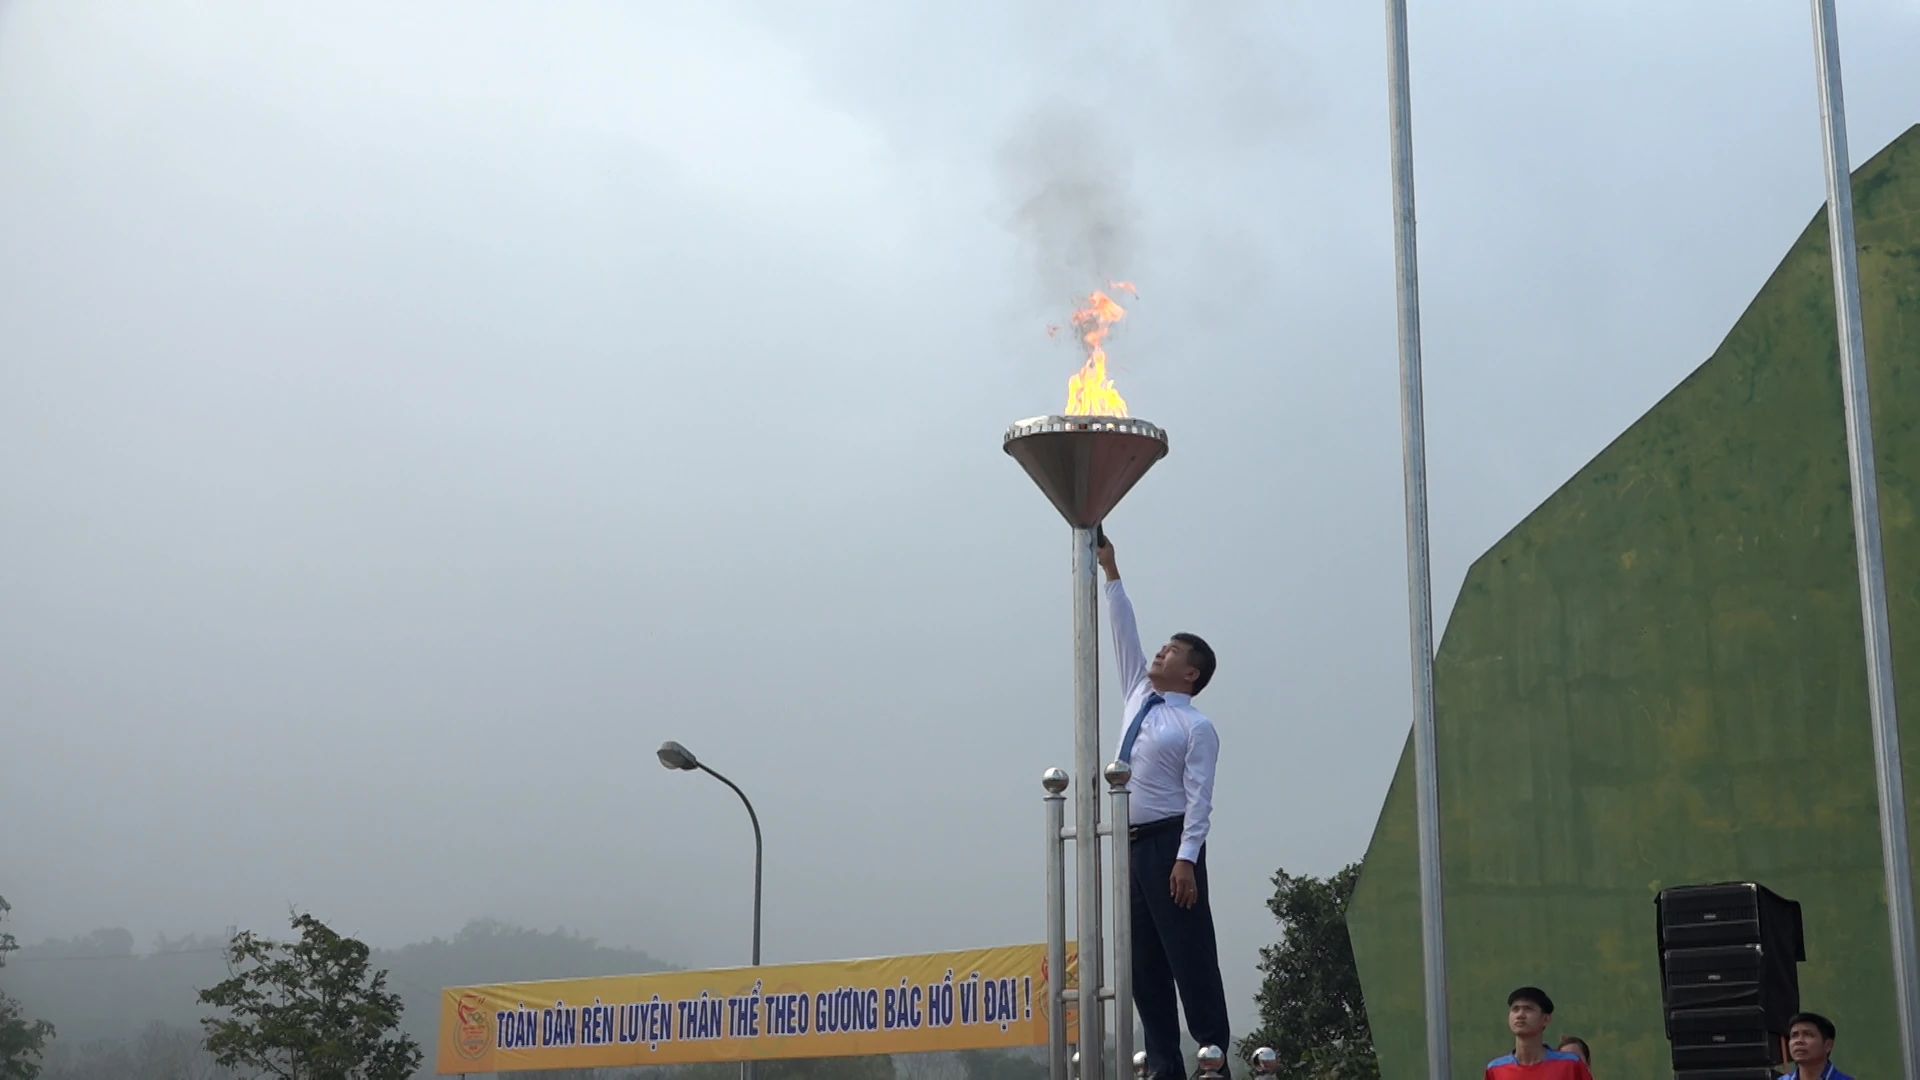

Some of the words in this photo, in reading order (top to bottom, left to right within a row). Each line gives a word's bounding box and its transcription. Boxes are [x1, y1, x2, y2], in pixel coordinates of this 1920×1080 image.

[497, 1001, 537, 1048] TOÀN
[543, 1000, 576, 1046] DÂN
[581, 997, 614, 1044] RÈN
[619, 994, 672, 1050] LUYỆN
[678, 991, 723, 1039] THÂN
[728, 979, 760, 1036] THỂ
[766, 992, 809, 1035] THEO
[815, 987, 877, 1032] GƯƠNG
[884, 978, 922, 1029] BÁC
[928, 968, 953, 1026] HỒ
[960, 972, 980, 1024] VĨ
[984, 977, 1017, 1031] ĐẠI
[1024, 976, 1031, 1020] !
